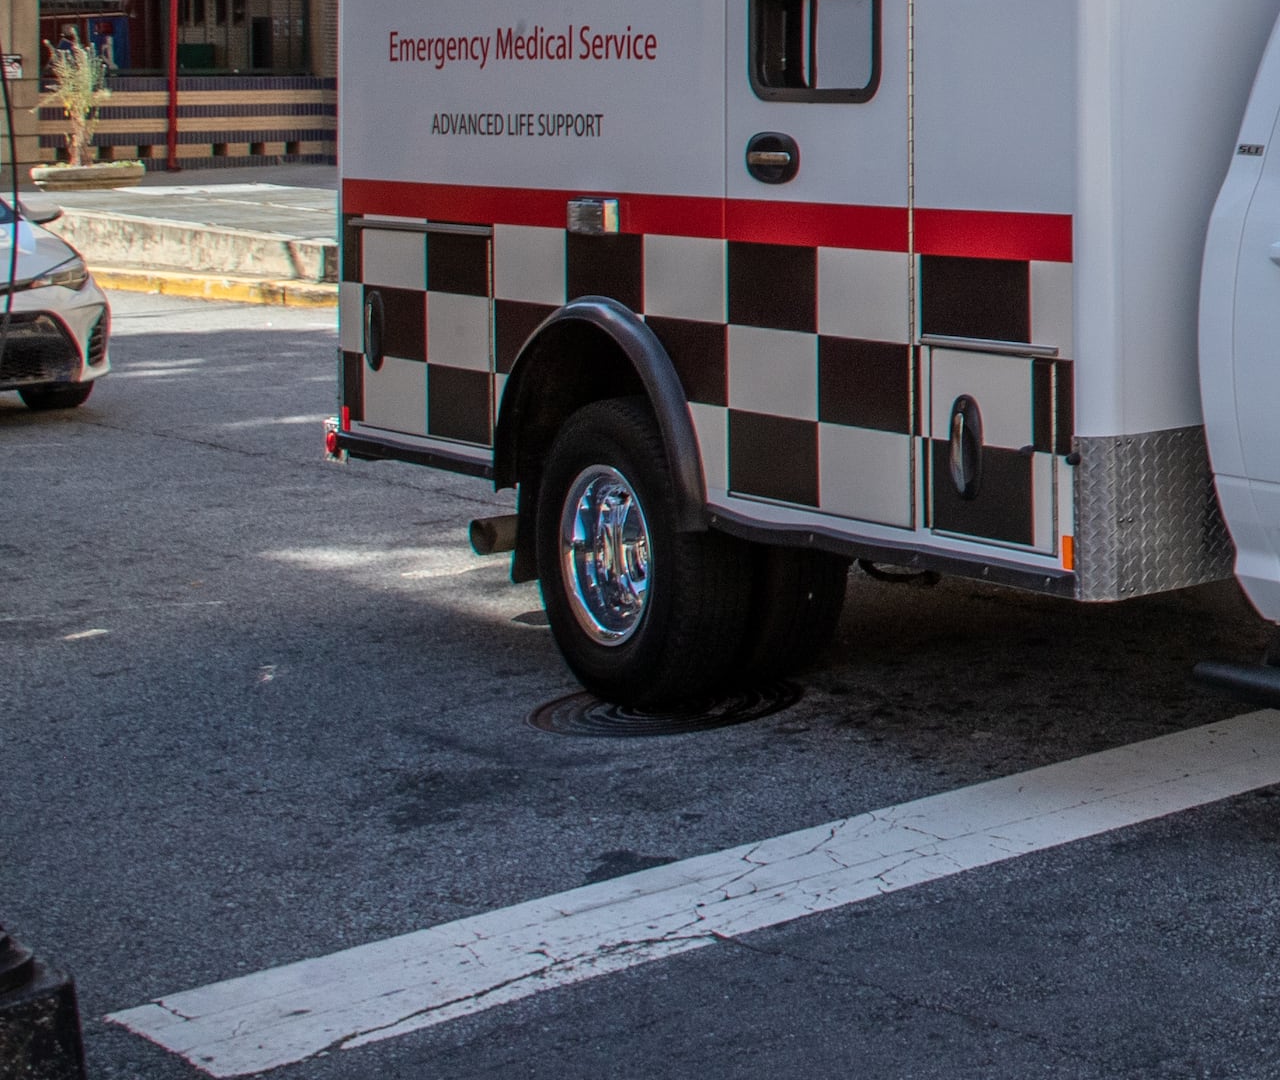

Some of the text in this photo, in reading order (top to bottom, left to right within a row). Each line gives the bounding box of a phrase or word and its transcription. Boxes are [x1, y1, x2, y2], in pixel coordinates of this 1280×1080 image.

[389, 25, 658, 70] Emergency Medical Service
[432, 112, 604, 137] ADVANCED LIFE SUPPORT
